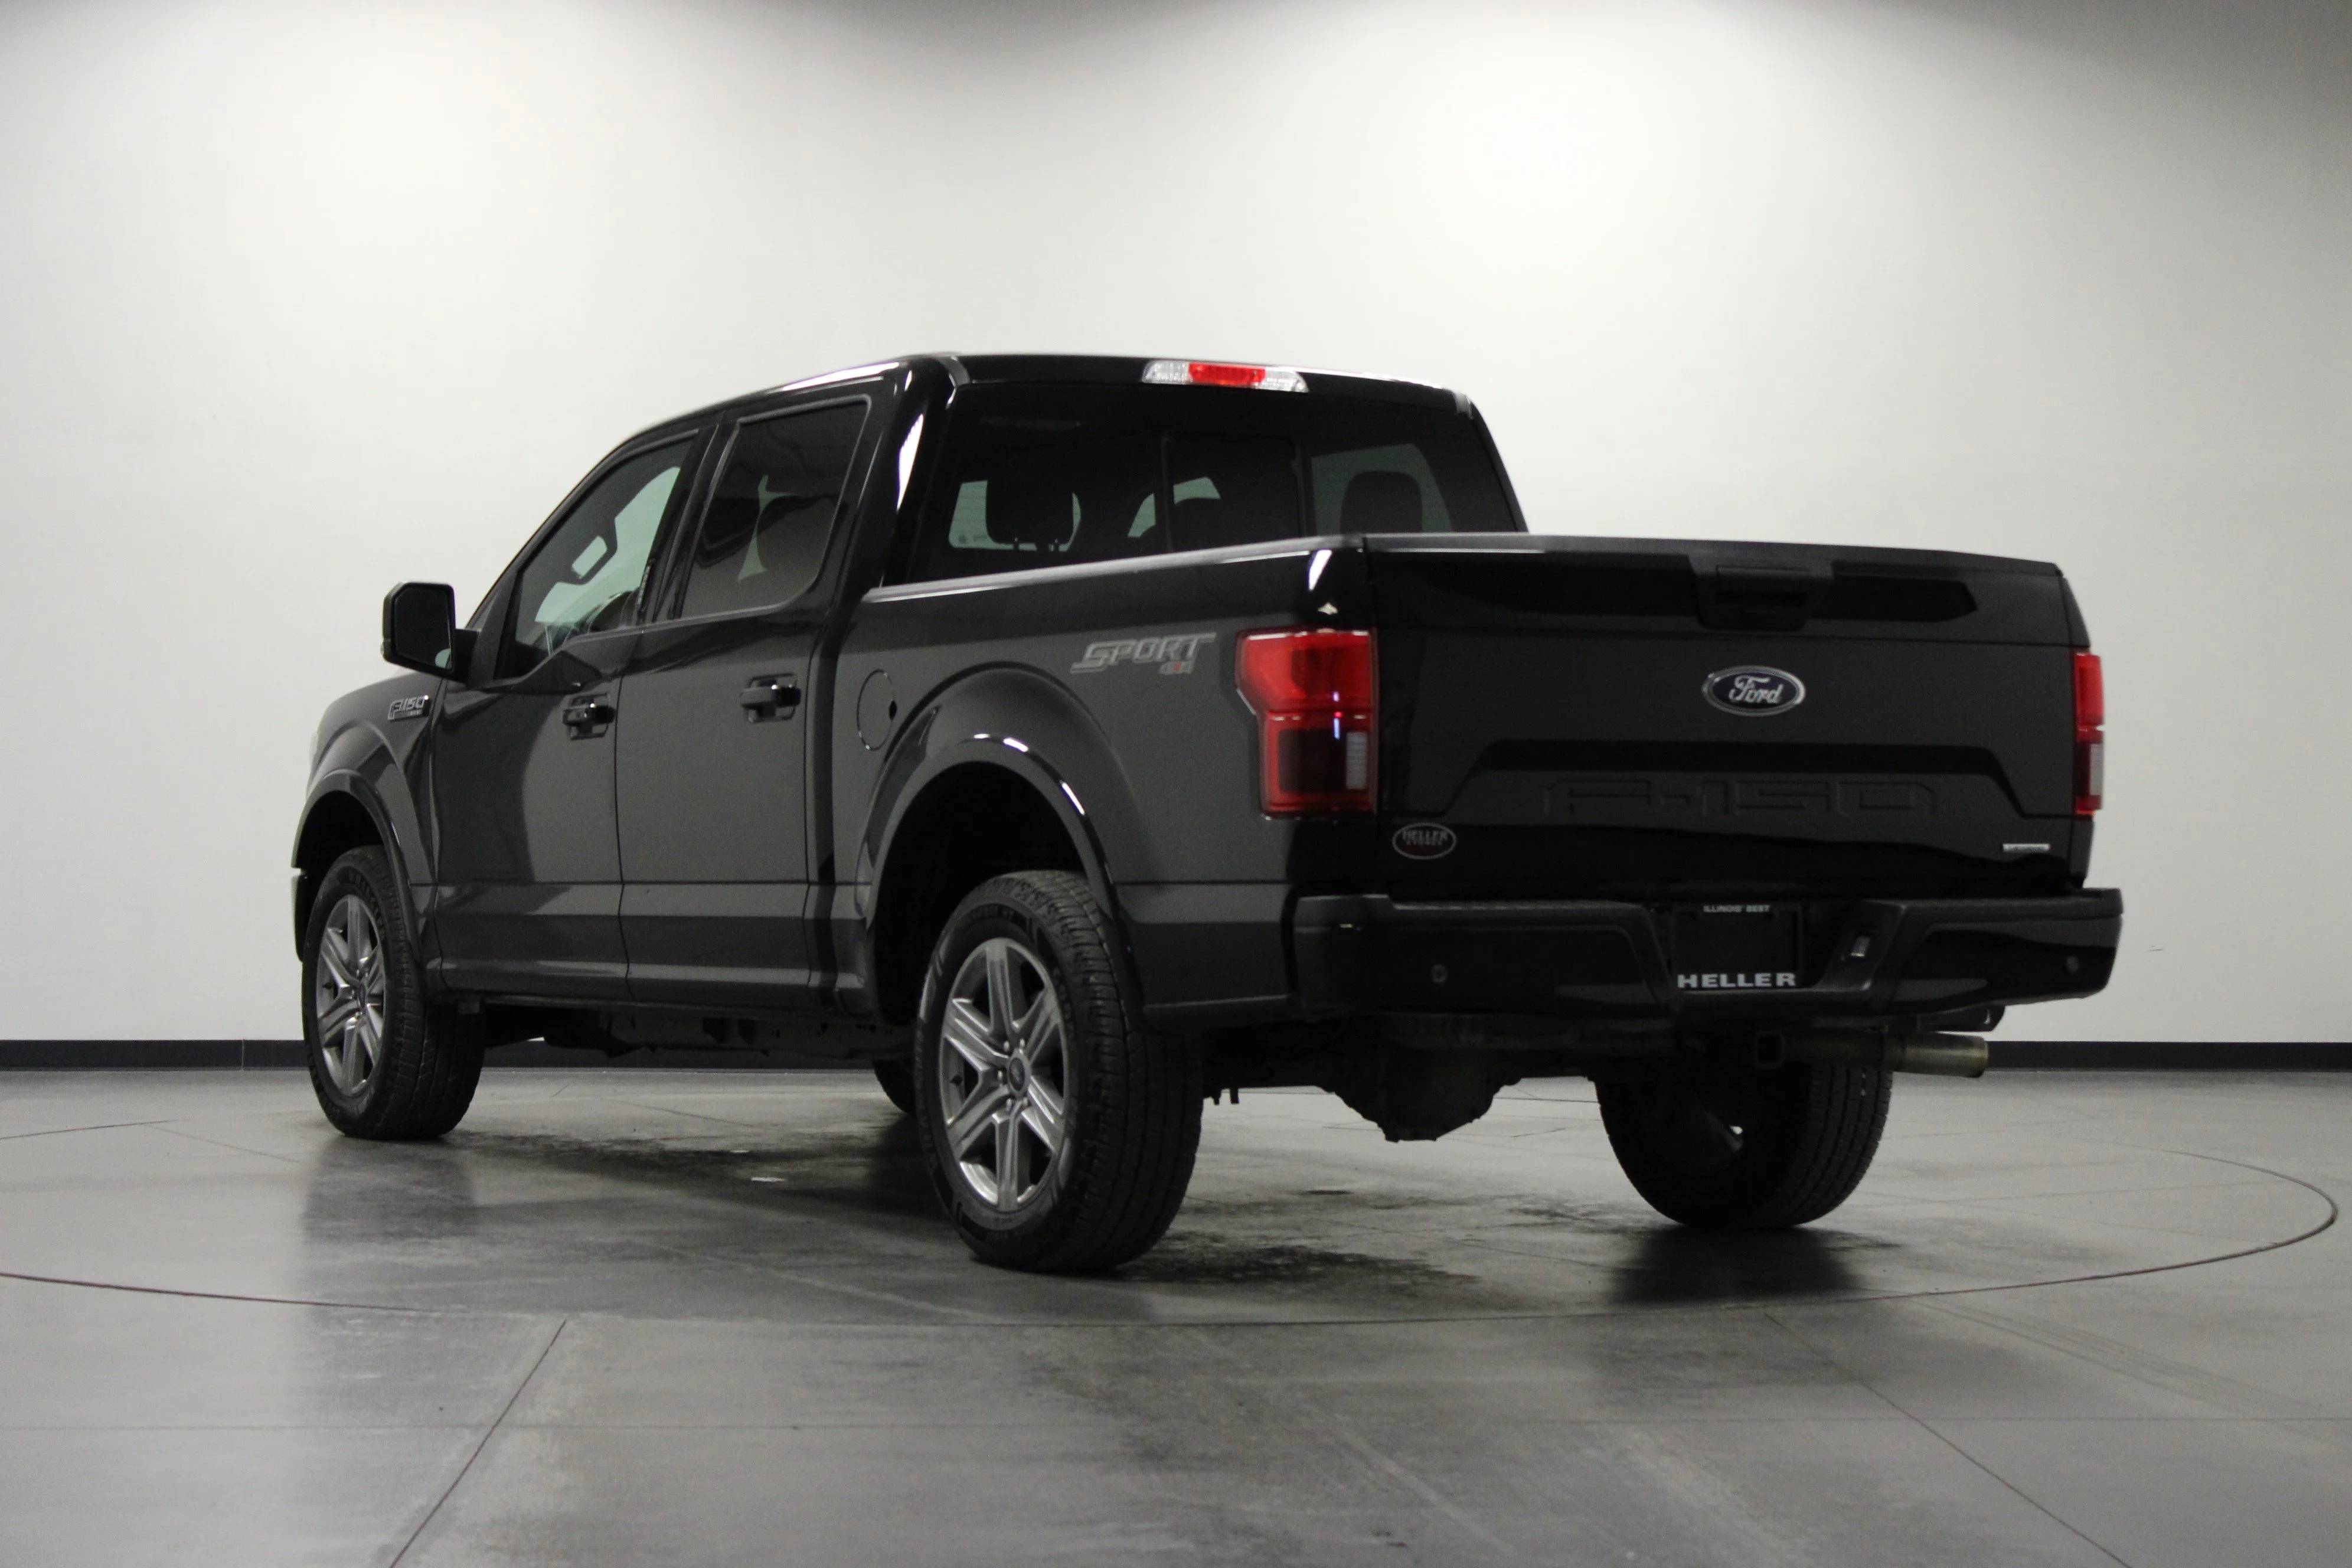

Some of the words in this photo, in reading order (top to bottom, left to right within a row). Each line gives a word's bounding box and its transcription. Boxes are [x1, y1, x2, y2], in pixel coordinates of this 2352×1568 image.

[1070, 632, 1217, 673] SPORT
[1728, 675, 1784, 704] Ford
[1677, 972, 1796, 988] HELLER
